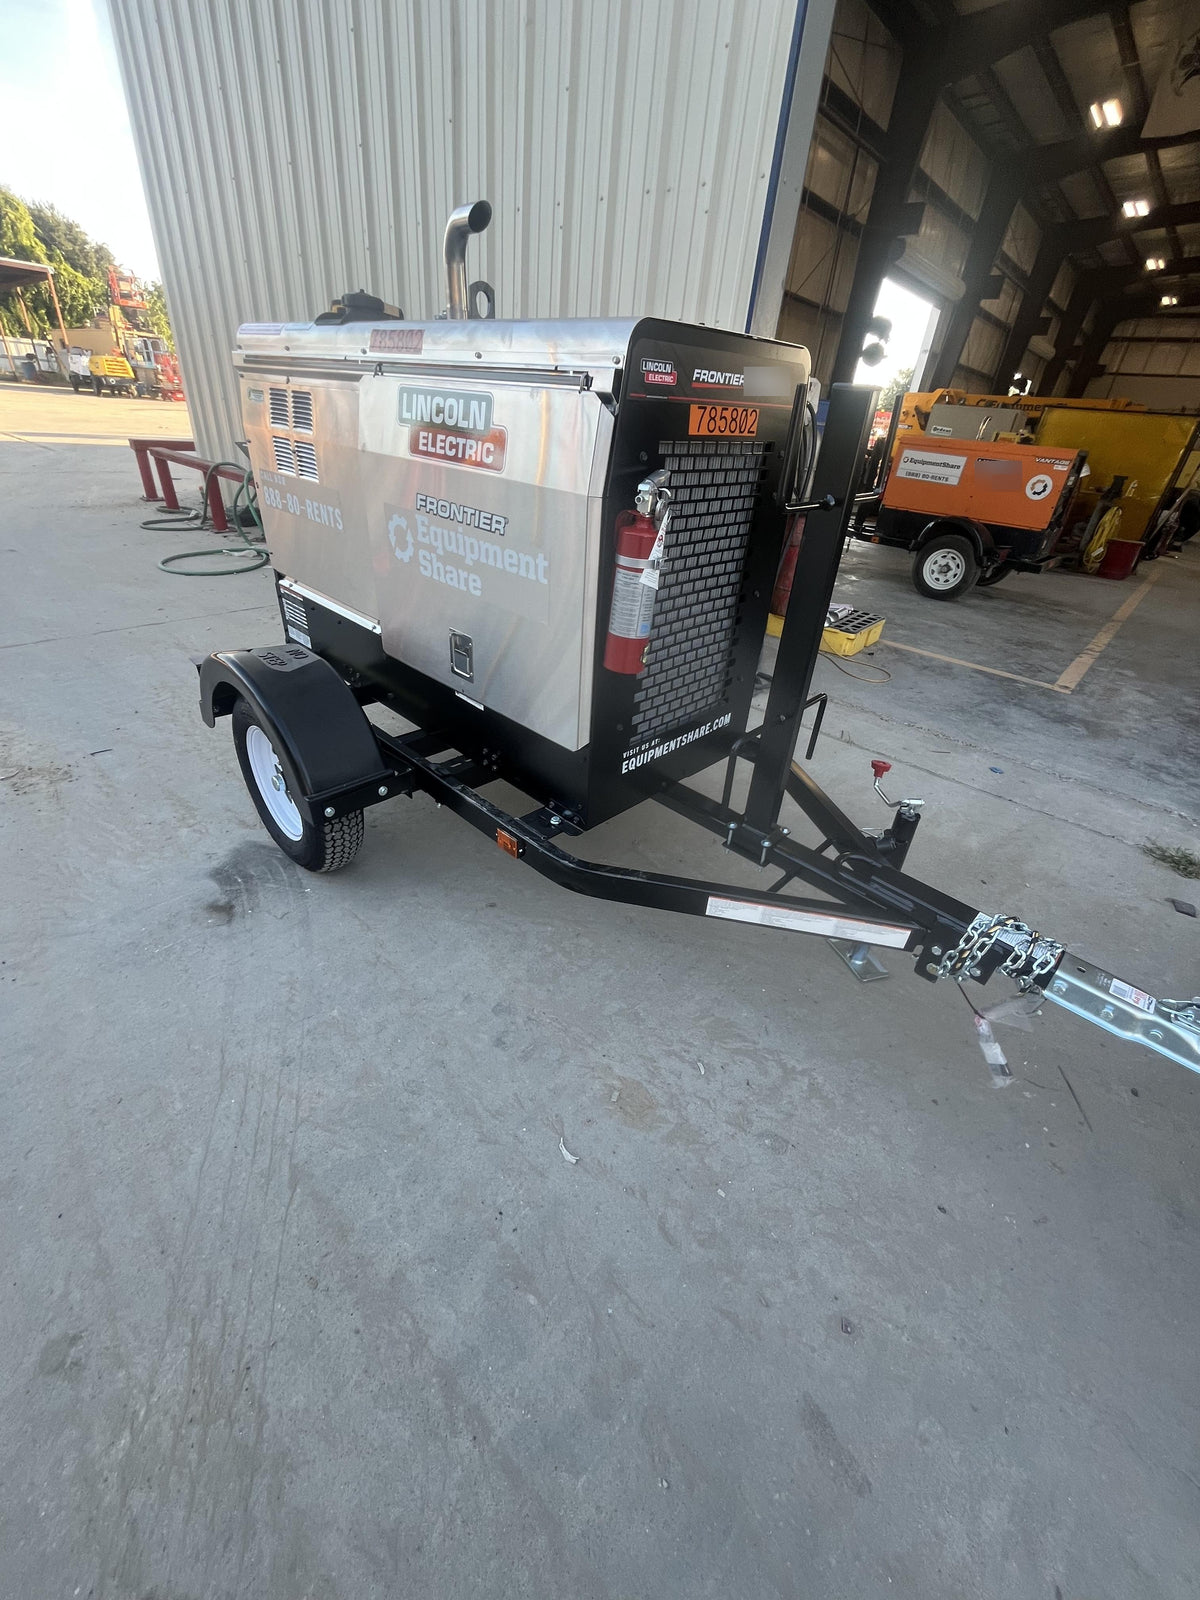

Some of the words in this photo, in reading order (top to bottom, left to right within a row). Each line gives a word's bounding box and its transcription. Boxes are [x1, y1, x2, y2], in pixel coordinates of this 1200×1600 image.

[642, 361, 672, 373] LINCOLN
[648, 373, 674, 383] ELECTRIC
[402, 393, 486, 430] LINCOLN
[696, 406, 758, 435] 785802
[418, 431, 494, 464] ELECTRIC
[1035, 457, 1070, 465] VANTAGE
[909, 457, 961, 470] EquipmentShare
[416, 493, 508, 536] FRONTIER
[415, 513, 549, 585] Equipment
[418, 549, 482, 597] Share
[621, 712, 732, 775] EQUIPMENTSHARE.COM
[623, 746, 640, 759] VISIT
[641, 742, 650, 751] US
